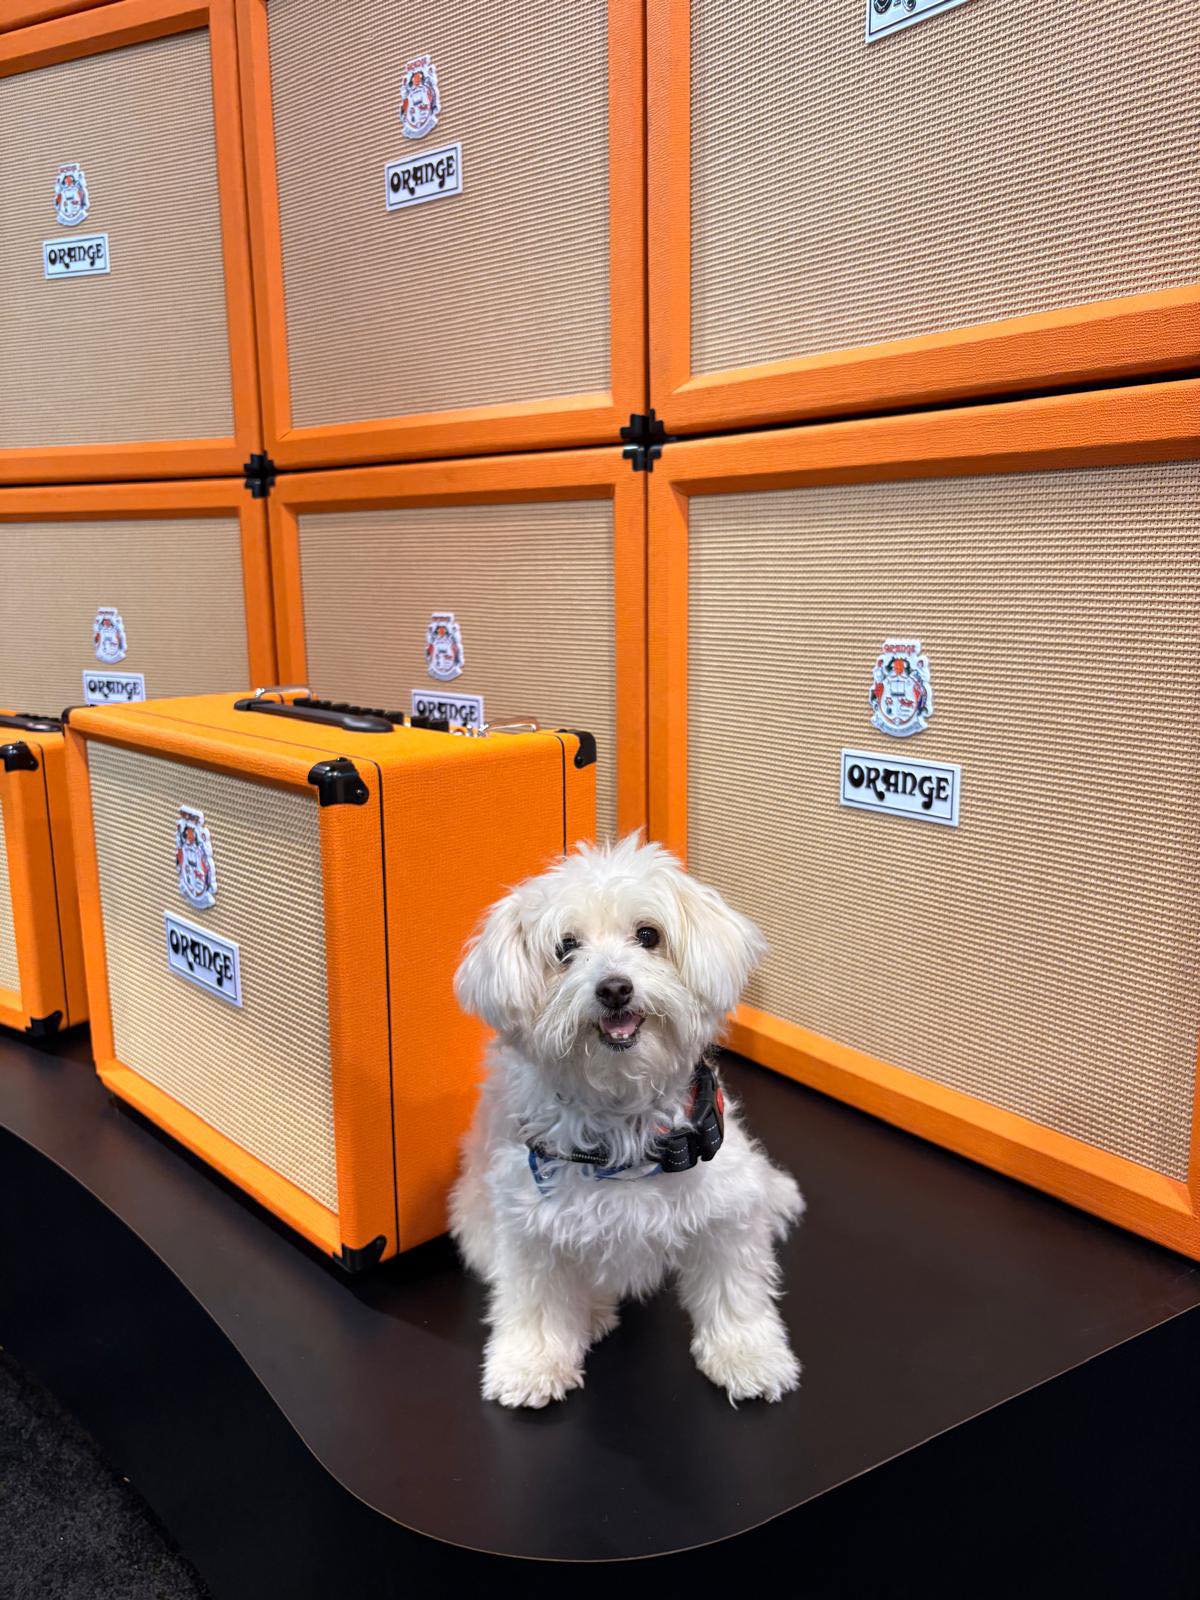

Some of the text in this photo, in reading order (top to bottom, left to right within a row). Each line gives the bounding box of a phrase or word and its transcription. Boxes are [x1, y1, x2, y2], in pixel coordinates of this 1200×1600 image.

[390, 155, 455, 196] ORANGE
[48, 243, 104, 269] ORANGE
[88, 679, 140, 700] ORANGE
[416, 700, 478, 726] ORANGE
[847, 764, 950, 810] ORANGE
[169, 929, 233, 987] ORANGE
